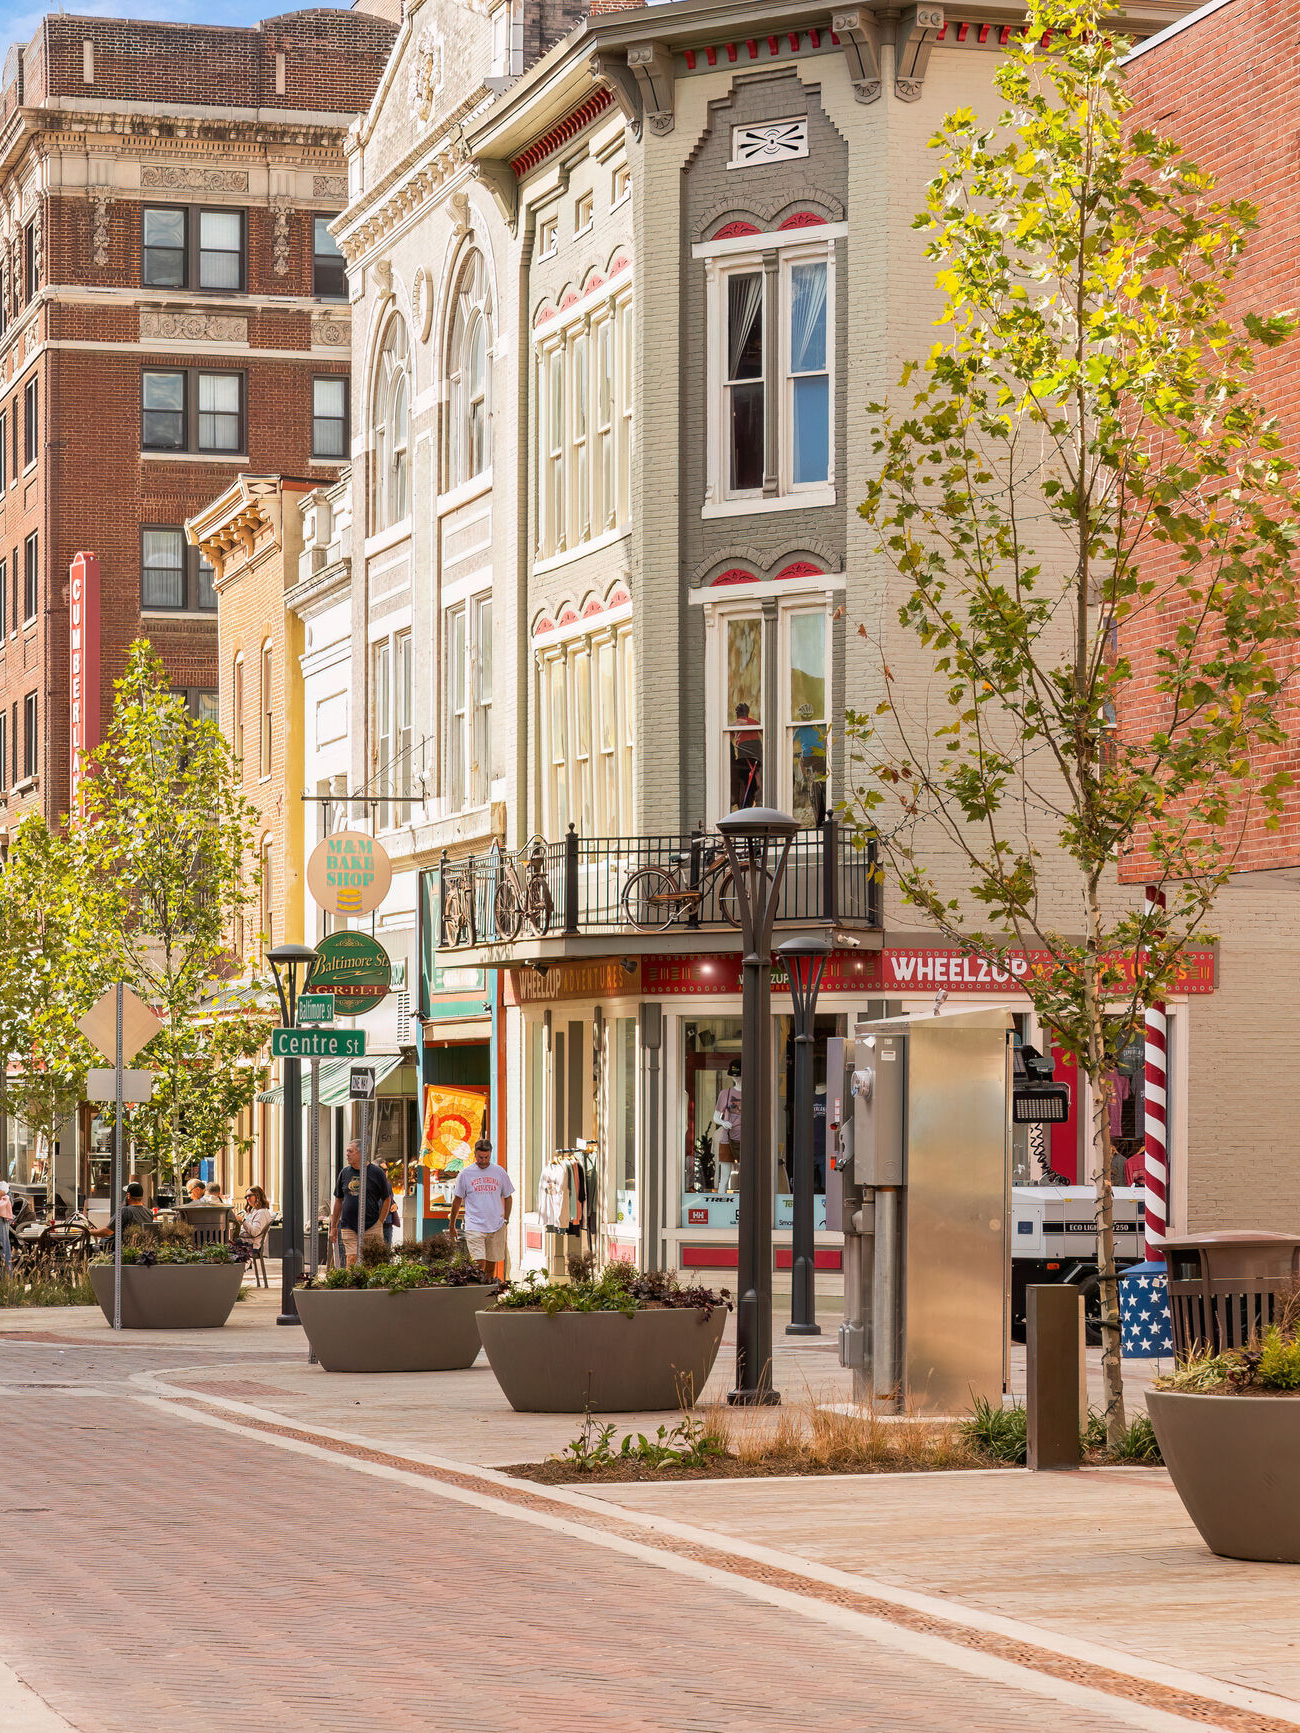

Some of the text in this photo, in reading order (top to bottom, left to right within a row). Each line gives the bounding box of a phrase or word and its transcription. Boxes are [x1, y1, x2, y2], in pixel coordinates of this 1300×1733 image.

[327, 839, 373, 854] M&M
[326, 855, 374, 870] BAKE
[326, 872, 374, 887] SHOP
[312, 953, 372, 977] Baltimore
[891, 957, 1028, 983] WHEELZUP
[519, 964, 624, 999] WHEELZUP ADVENTURES
[299, 999, 325, 1020] Baltimore
[278, 1034, 359, 1054] Centre St
